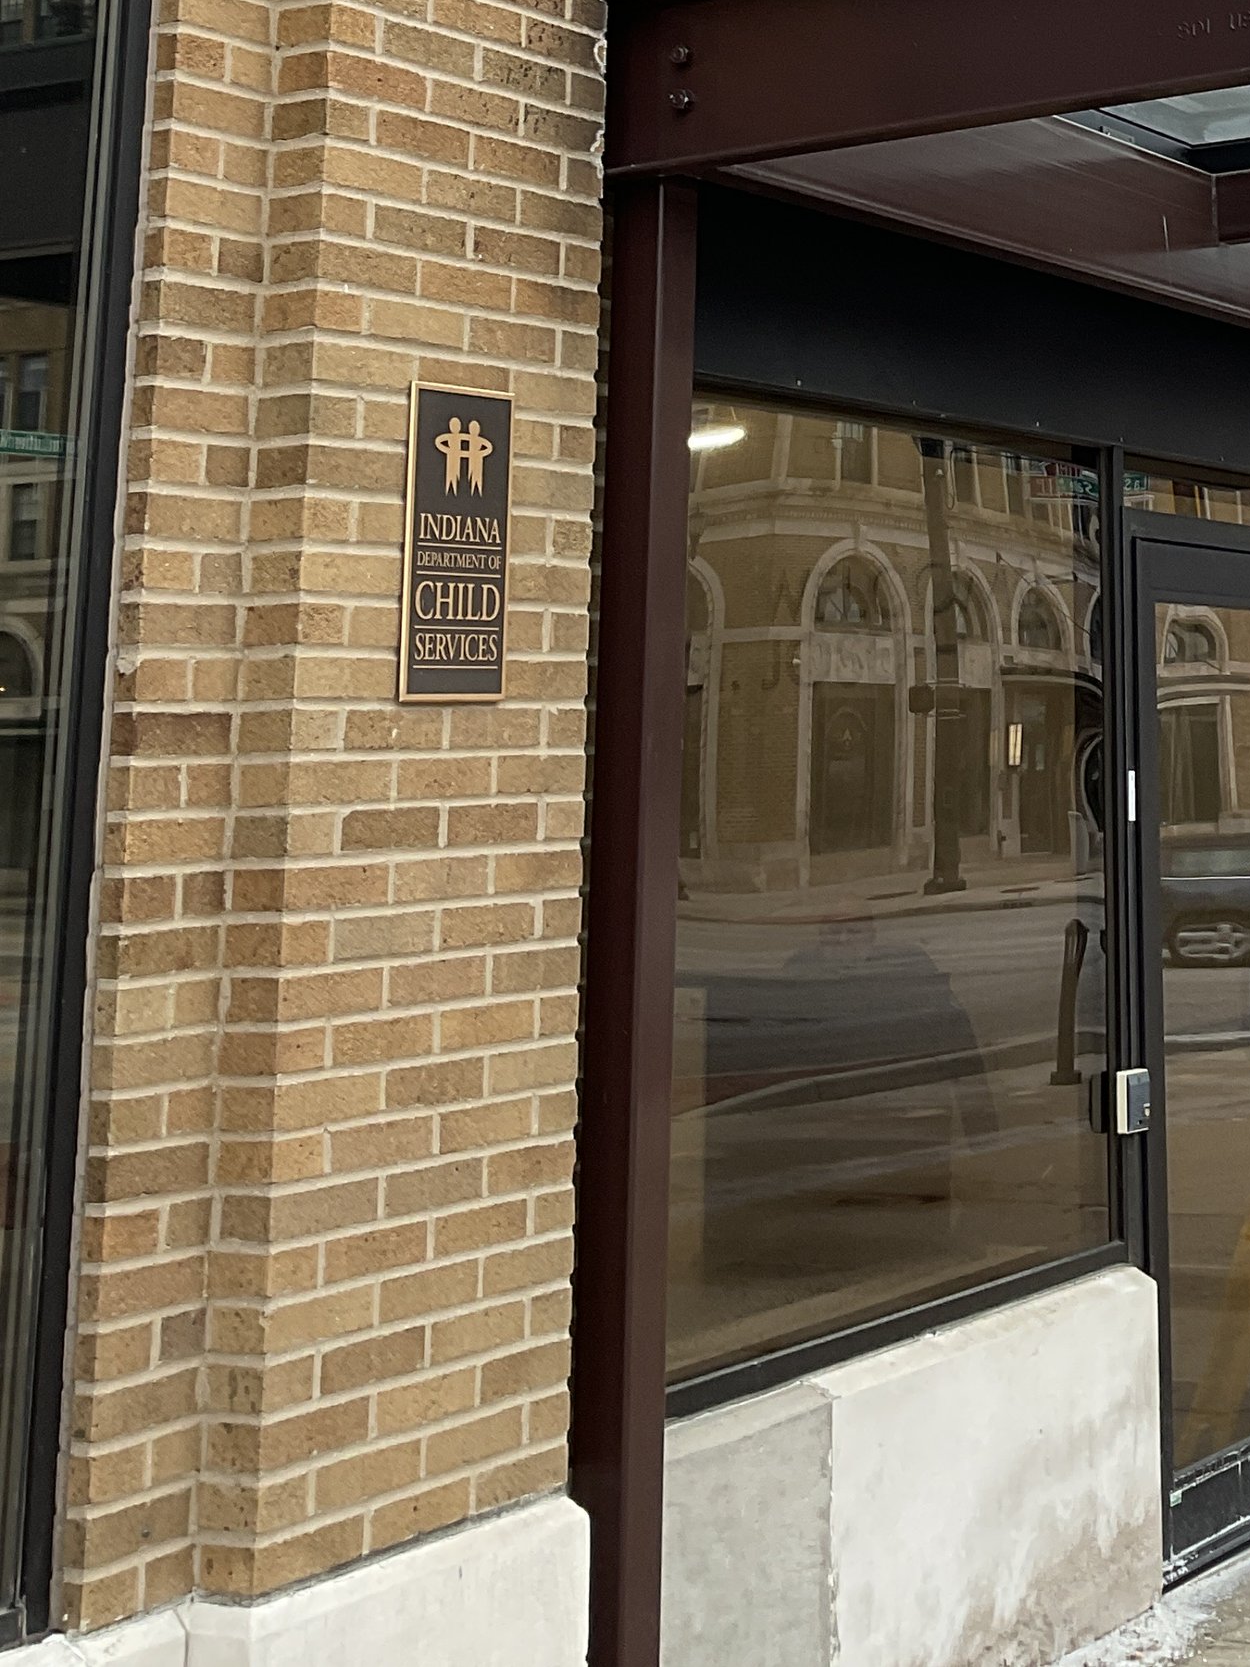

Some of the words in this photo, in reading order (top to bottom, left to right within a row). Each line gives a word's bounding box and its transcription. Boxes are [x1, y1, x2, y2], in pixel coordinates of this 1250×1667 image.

[418, 513, 501, 544] INDIANA
[416, 550, 485, 569] DEPARTMENT
[488, 554, 502, 570] OF
[414, 580, 500, 621] CHILD
[414, 633, 498, 662] SERVICES
